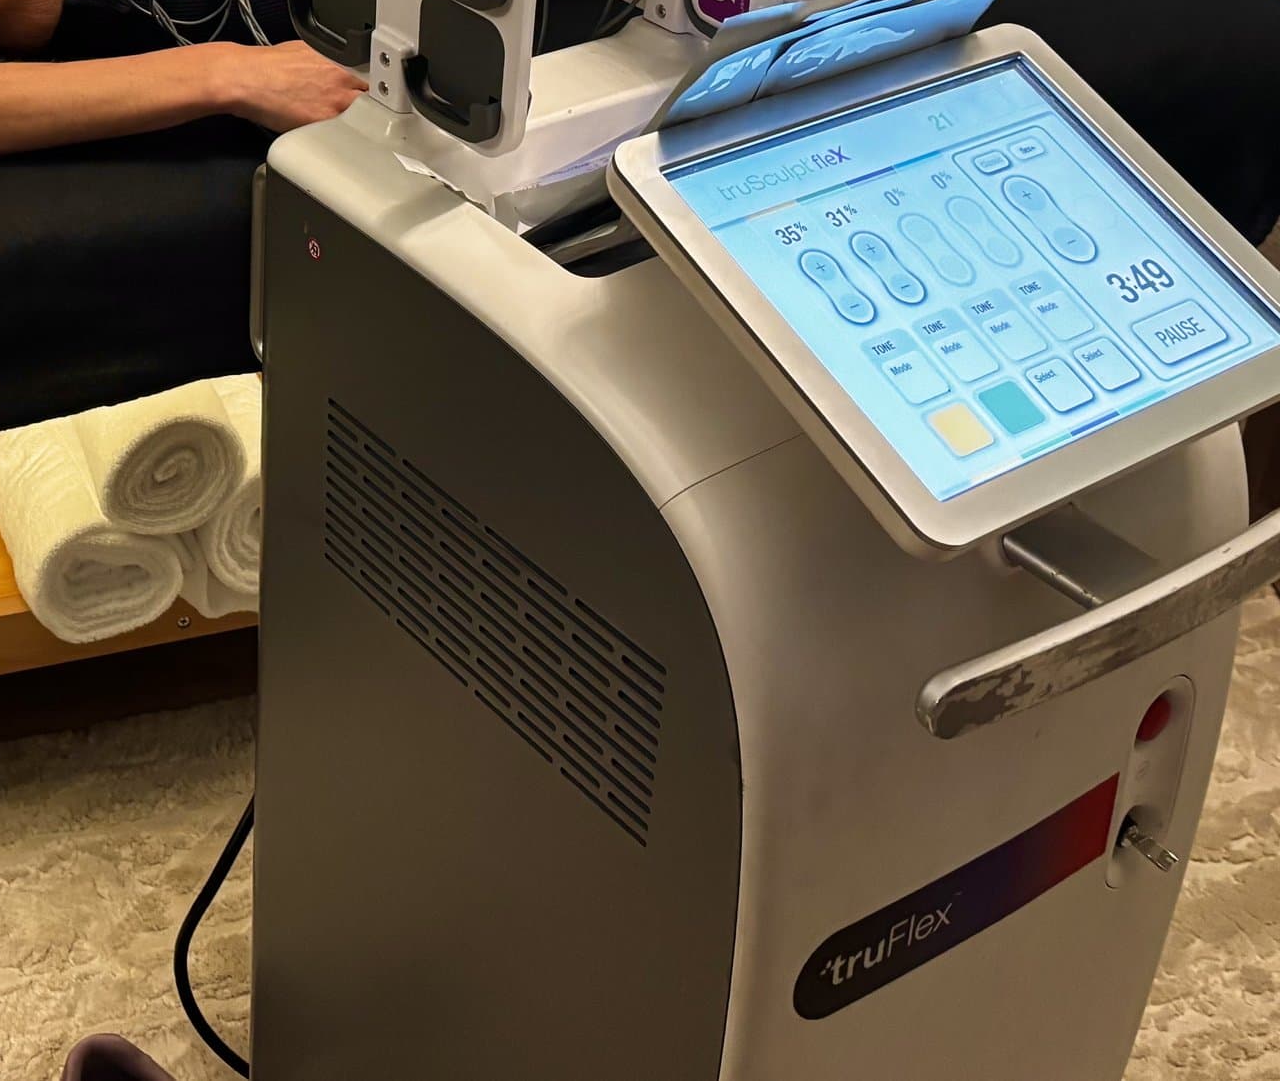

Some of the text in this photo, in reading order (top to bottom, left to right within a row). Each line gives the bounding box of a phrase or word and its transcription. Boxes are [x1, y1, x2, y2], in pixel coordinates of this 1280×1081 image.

[928, 112, 954, 131] 21
[717, 159, 812, 201] truSculpt
[775, 170, 953, 245] 35% 31% 0% 0%
[1106, 258, 1175, 303] 3:49
[1019, 281, 1042, 296] TONE
[971, 300, 995, 315] TONE
[1036, 301, 1059, 314] Mode
[922, 320, 947, 335] TONE
[990, 320, 1013, 335] Mode
[1155, 317, 1206, 348] PAUSE
[871, 340, 896, 356] TONE
[940, 341, 963, 355] Mode
[1081, 348, 1105, 362] Select
[889, 361, 913, 376] Mode
[1034, 369, 1057, 384] Select
[826, 901, 954, 986] truFlex
